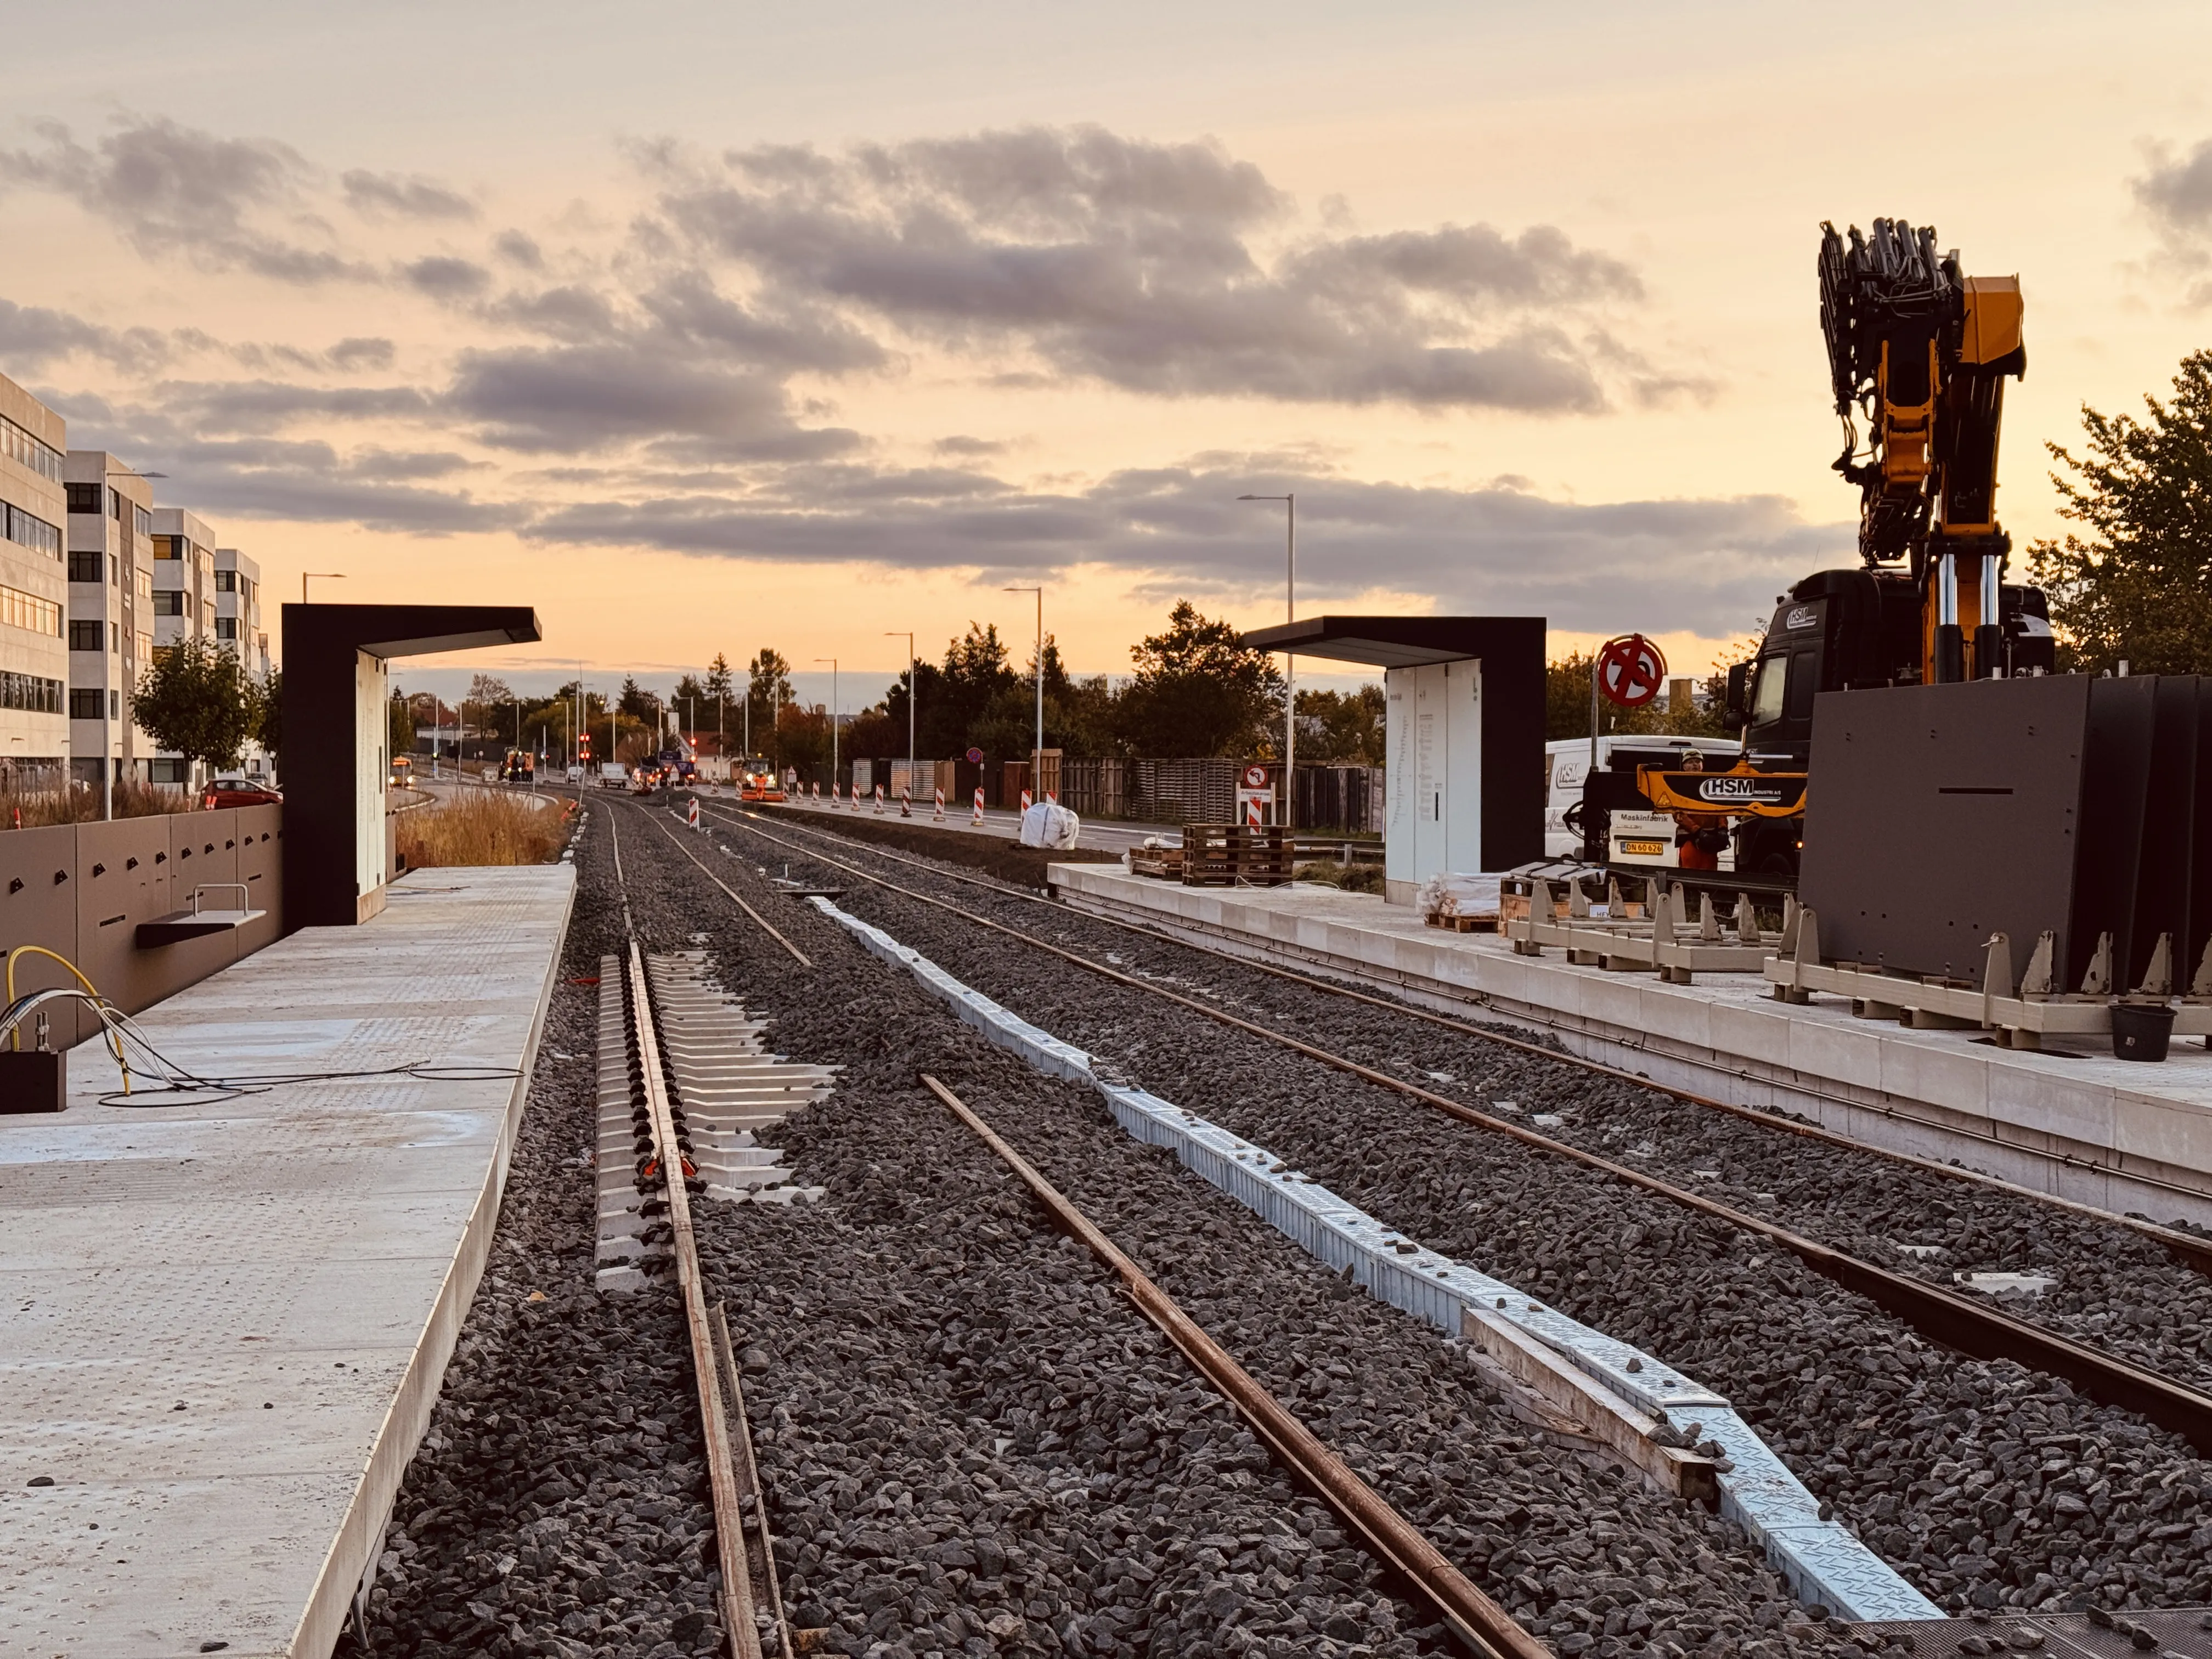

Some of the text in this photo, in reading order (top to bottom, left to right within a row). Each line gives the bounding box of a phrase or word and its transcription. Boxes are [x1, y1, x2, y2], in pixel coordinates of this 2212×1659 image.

[1791, 607, 1808, 622] HSM
[1561, 763, 1579, 782] HSM
[1711, 779, 1754, 795] HSM
[1621, 814, 1668, 822] Maskinfabrik
